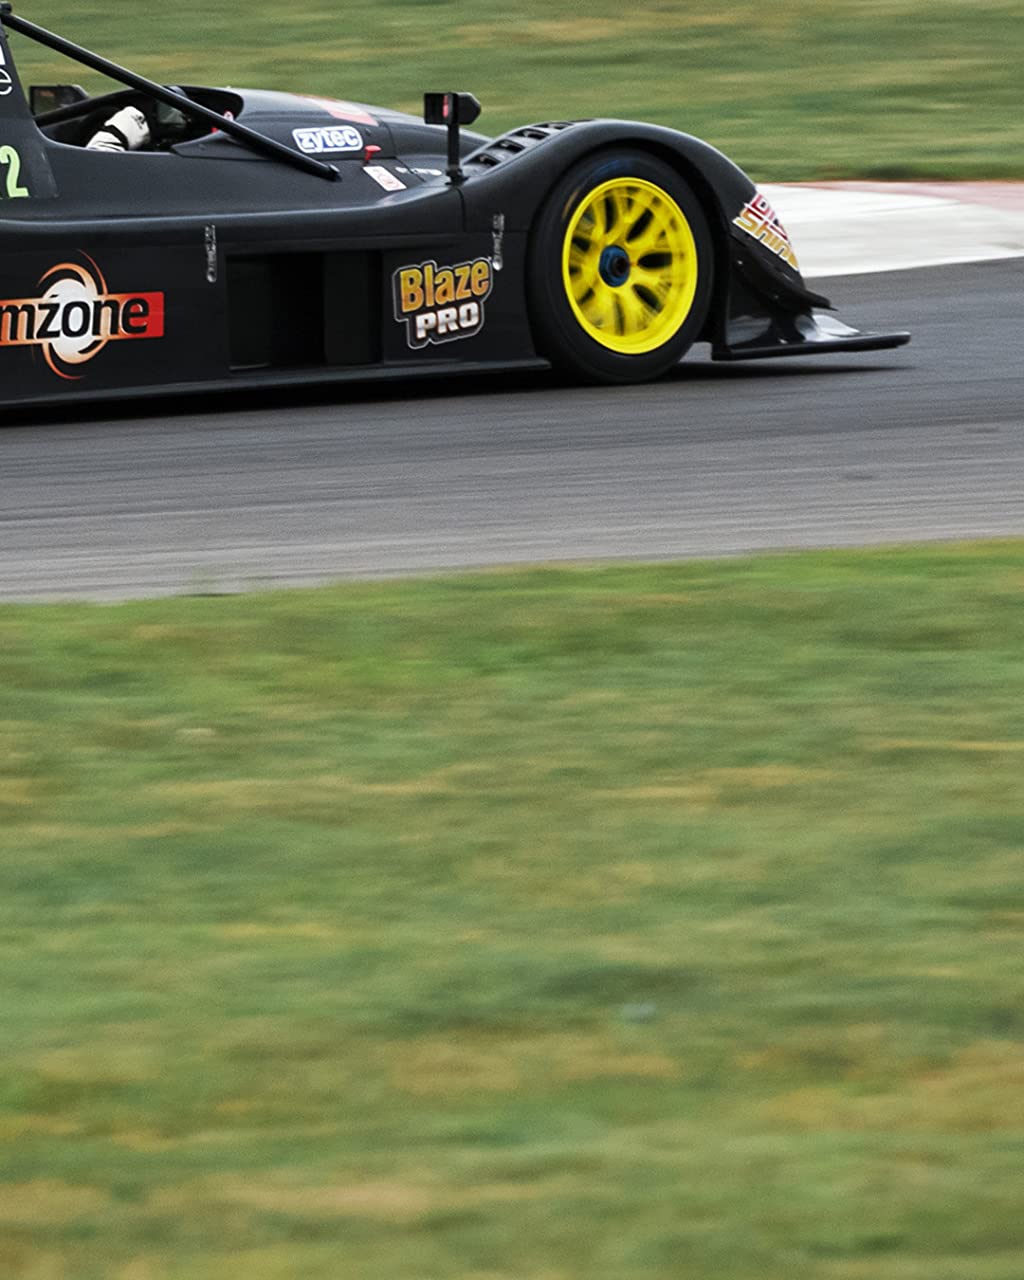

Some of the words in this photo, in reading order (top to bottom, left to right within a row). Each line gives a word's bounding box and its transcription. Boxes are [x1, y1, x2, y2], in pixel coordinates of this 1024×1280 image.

[297, 128, 359, 153] zytec
[400, 261, 489, 313] Blaze
[416, 302, 479, 339] PRO
